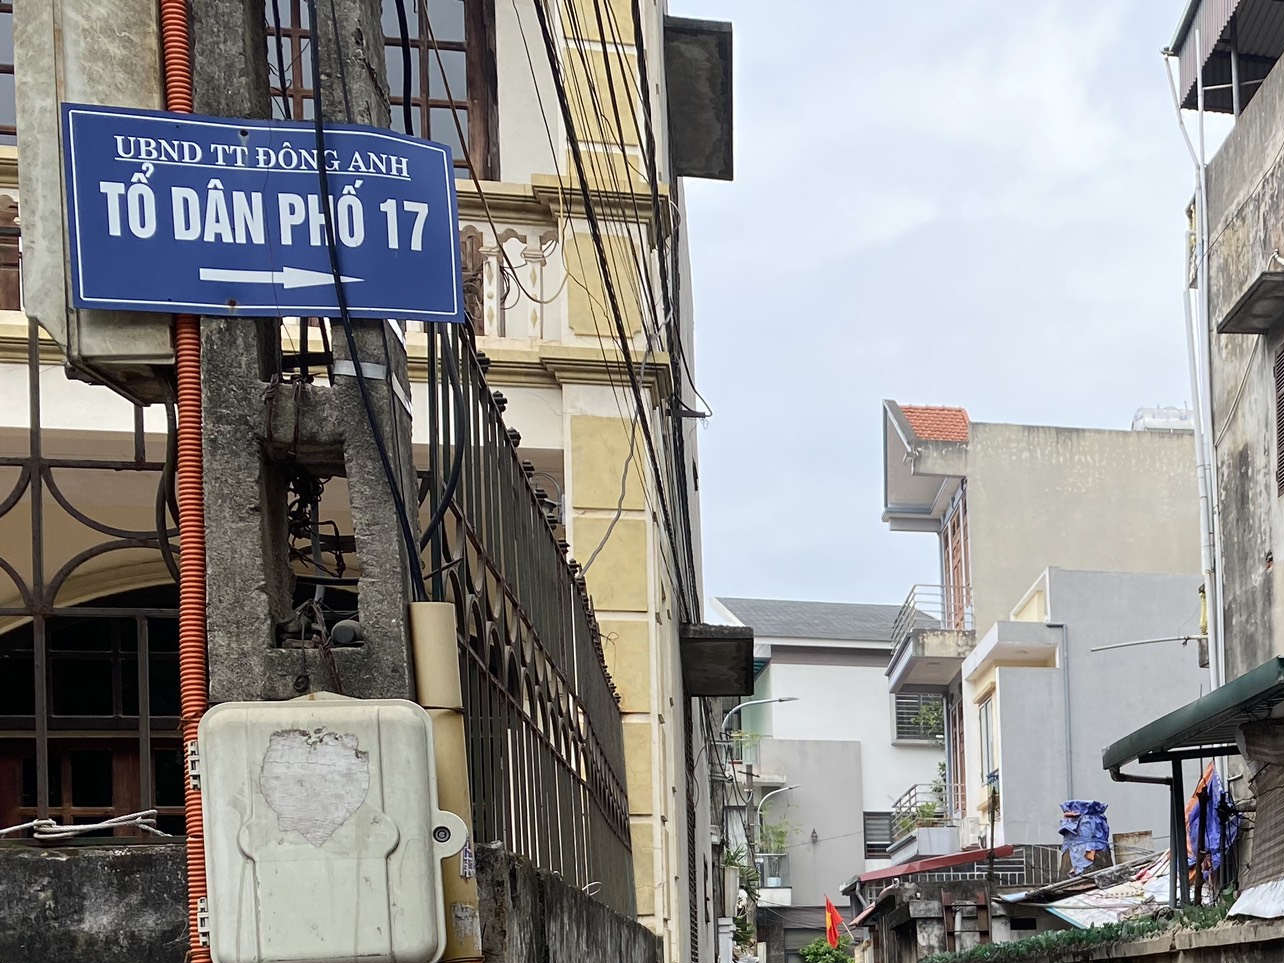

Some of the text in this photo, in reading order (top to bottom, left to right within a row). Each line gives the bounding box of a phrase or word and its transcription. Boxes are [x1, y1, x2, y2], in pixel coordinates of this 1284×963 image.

[114, 136, 409, 177] UBND TT ĐÔNG ANH
[100, 162, 429, 251] TỔ DÂN PHỐ 17
